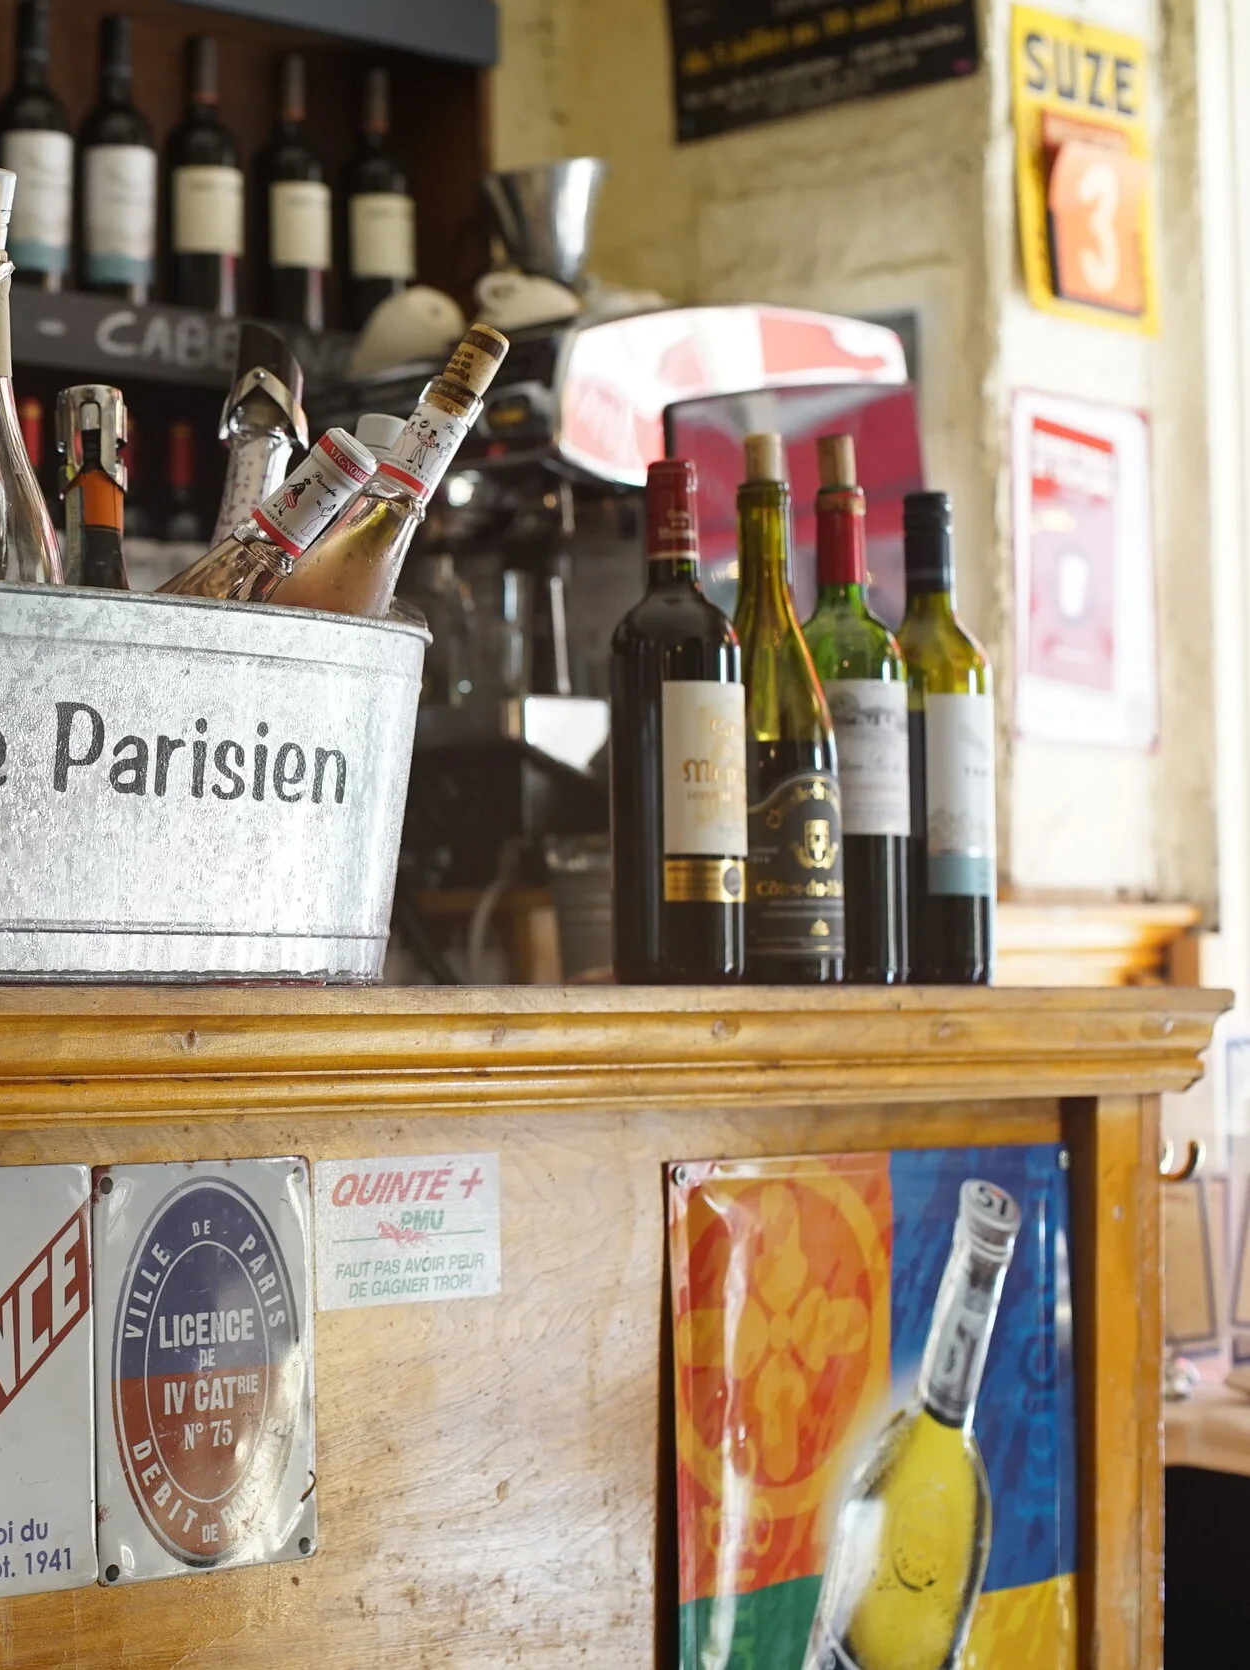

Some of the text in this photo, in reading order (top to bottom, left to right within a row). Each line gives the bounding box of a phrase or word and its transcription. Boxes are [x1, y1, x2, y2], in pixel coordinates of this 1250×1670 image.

[1024, 30, 1136, 116] SUZE
[1078, 161, 1121, 294] 3
[52, 702, 347, 804] Parisien
[331, 1160, 454, 1208] QUINTÉ
[978, 1185, 1008, 1217] 51
[400, 1208, 445, 1231] PMU
[124, 1219, 286, 1341] VILLE DE PARIS
[334, 1252, 485, 1280] FAUT PAS AVOIR PEUR
[348, 1281, 368, 1299] DE
[370, 1276, 430, 1297] GAGNER
[158, 1308, 256, 1350] LICENCE
[198, 1347, 216, 1369] DE
[163, 1379, 188, 1416] IV
[184, 1418, 234, 1451] N° 75
[131, 1437, 199, 1535] DEBIT
[200, 1522, 220, 1544] DE
[20, 1520, 48, 1542] du
[24, 1547, 73, 1575] 1941
